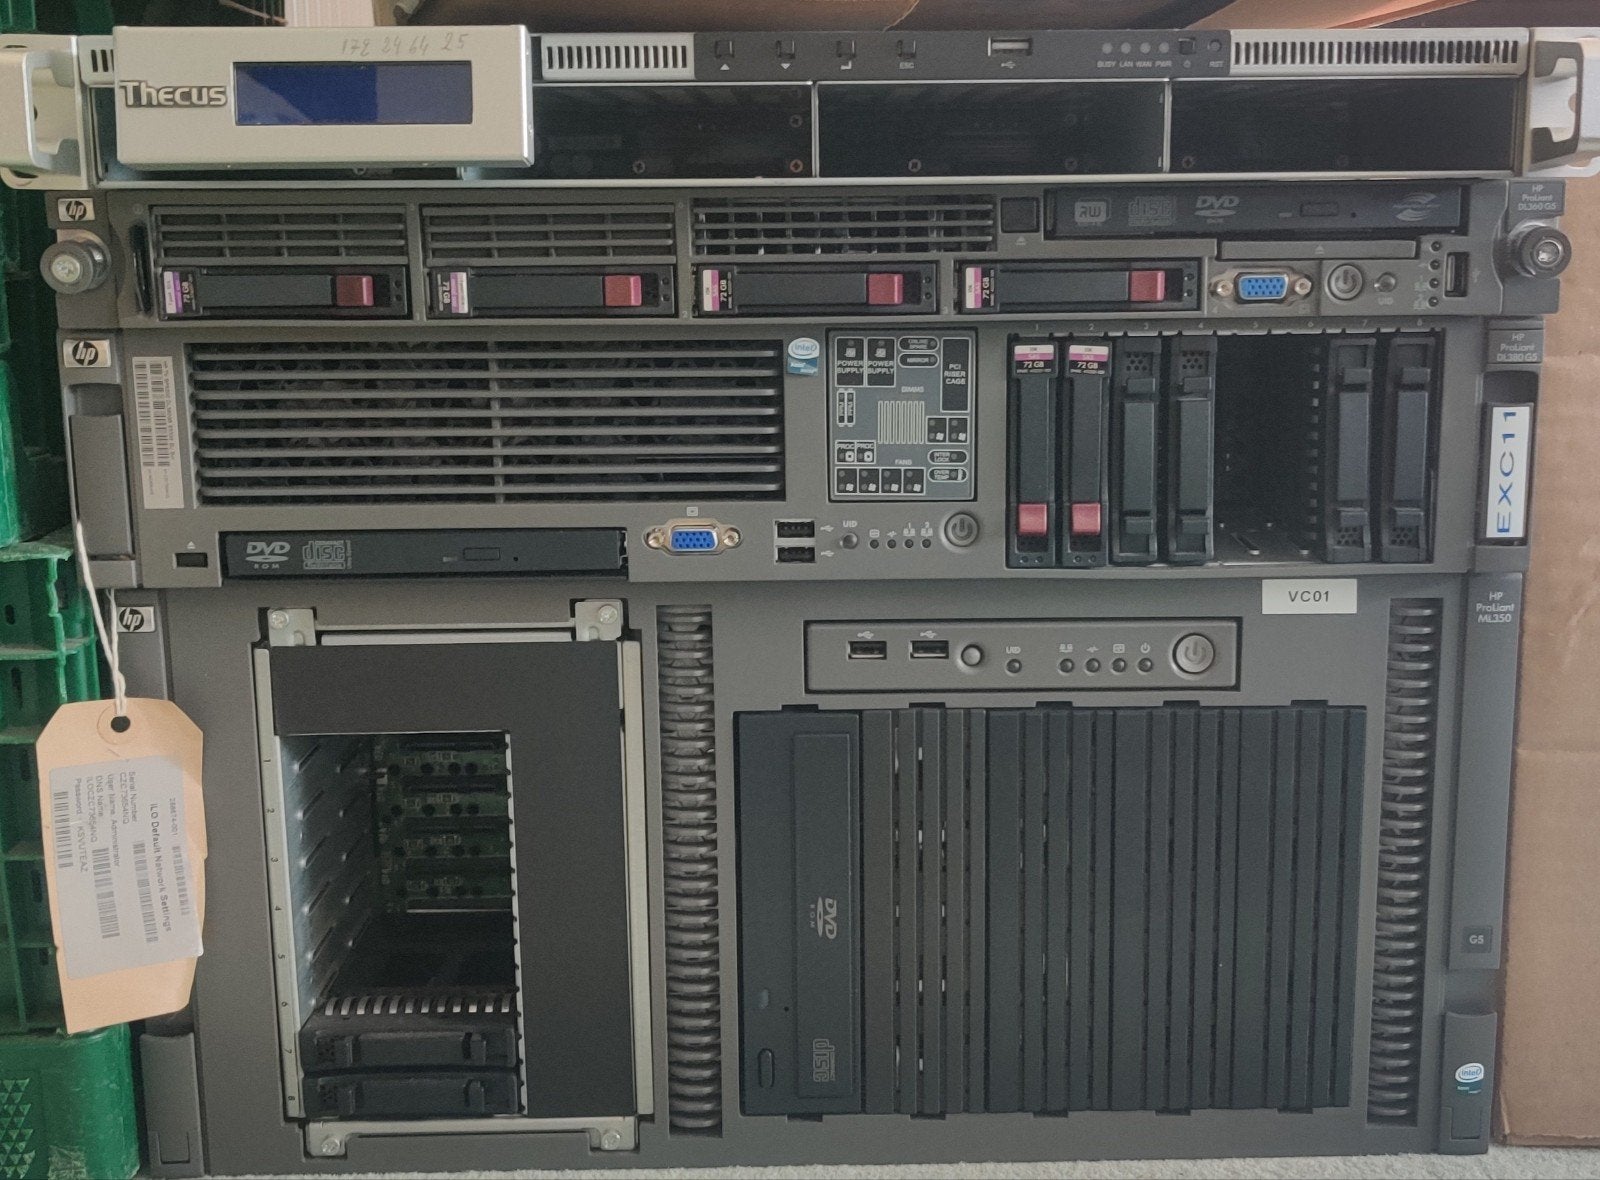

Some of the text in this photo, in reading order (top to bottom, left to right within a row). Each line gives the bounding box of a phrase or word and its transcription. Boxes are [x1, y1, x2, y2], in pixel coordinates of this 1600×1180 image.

[441, 32, 469, 51] 25
[1119, 60, 1133, 68] LAN
[1135, 60, 1152, 68] WAN
[1154, 60, 1172, 68] PWR
[119, 80, 228, 107] Thecus
[1531, 184, 1545, 193] HP
[1195, 195, 1240, 210] DVD
[1521, 193, 1553, 202] ProLiant
[67, 200, 86, 220] hp
[1518, 202, 1557, 211] DL360 G5
[1511, 332, 1526, 341] HP
[74, 341, 97, 366] hp
[1500, 343, 1535, 352] ProLiant
[1496, 353, 1538, 362] DL380 G5
[867, 367, 894, 375] SUPPLY
[1077, 361, 1087, 369] 72
[943, 370, 966, 378] RISER
[1497, 411, 1517, 533] EXC11
[842, 520, 858, 528] UID
[246, 541, 291, 556] DVD
[302, 540, 346, 561] disc
[1288, 590, 1330, 603] VC01
[1489, 591, 1504, 600] HP
[1476, 603, 1515, 613] ProLiant
[121, 607, 143, 632] hp
[1477, 613, 1512, 623] ML350
[1005, 646, 1022, 654] UID
[96, 775, 104, 793] DNS
[130, 793, 138, 822] Number
[111, 819, 120, 867] Administrator
[151, 821, 161, 854] Default
[154, 855, 166, 893] Network
[160, 894, 172, 932] Settings
[824, 897, 837, 940] DVD
[1469, 934, 1484, 945] G5
[813, 1038, 835, 1082] disc
